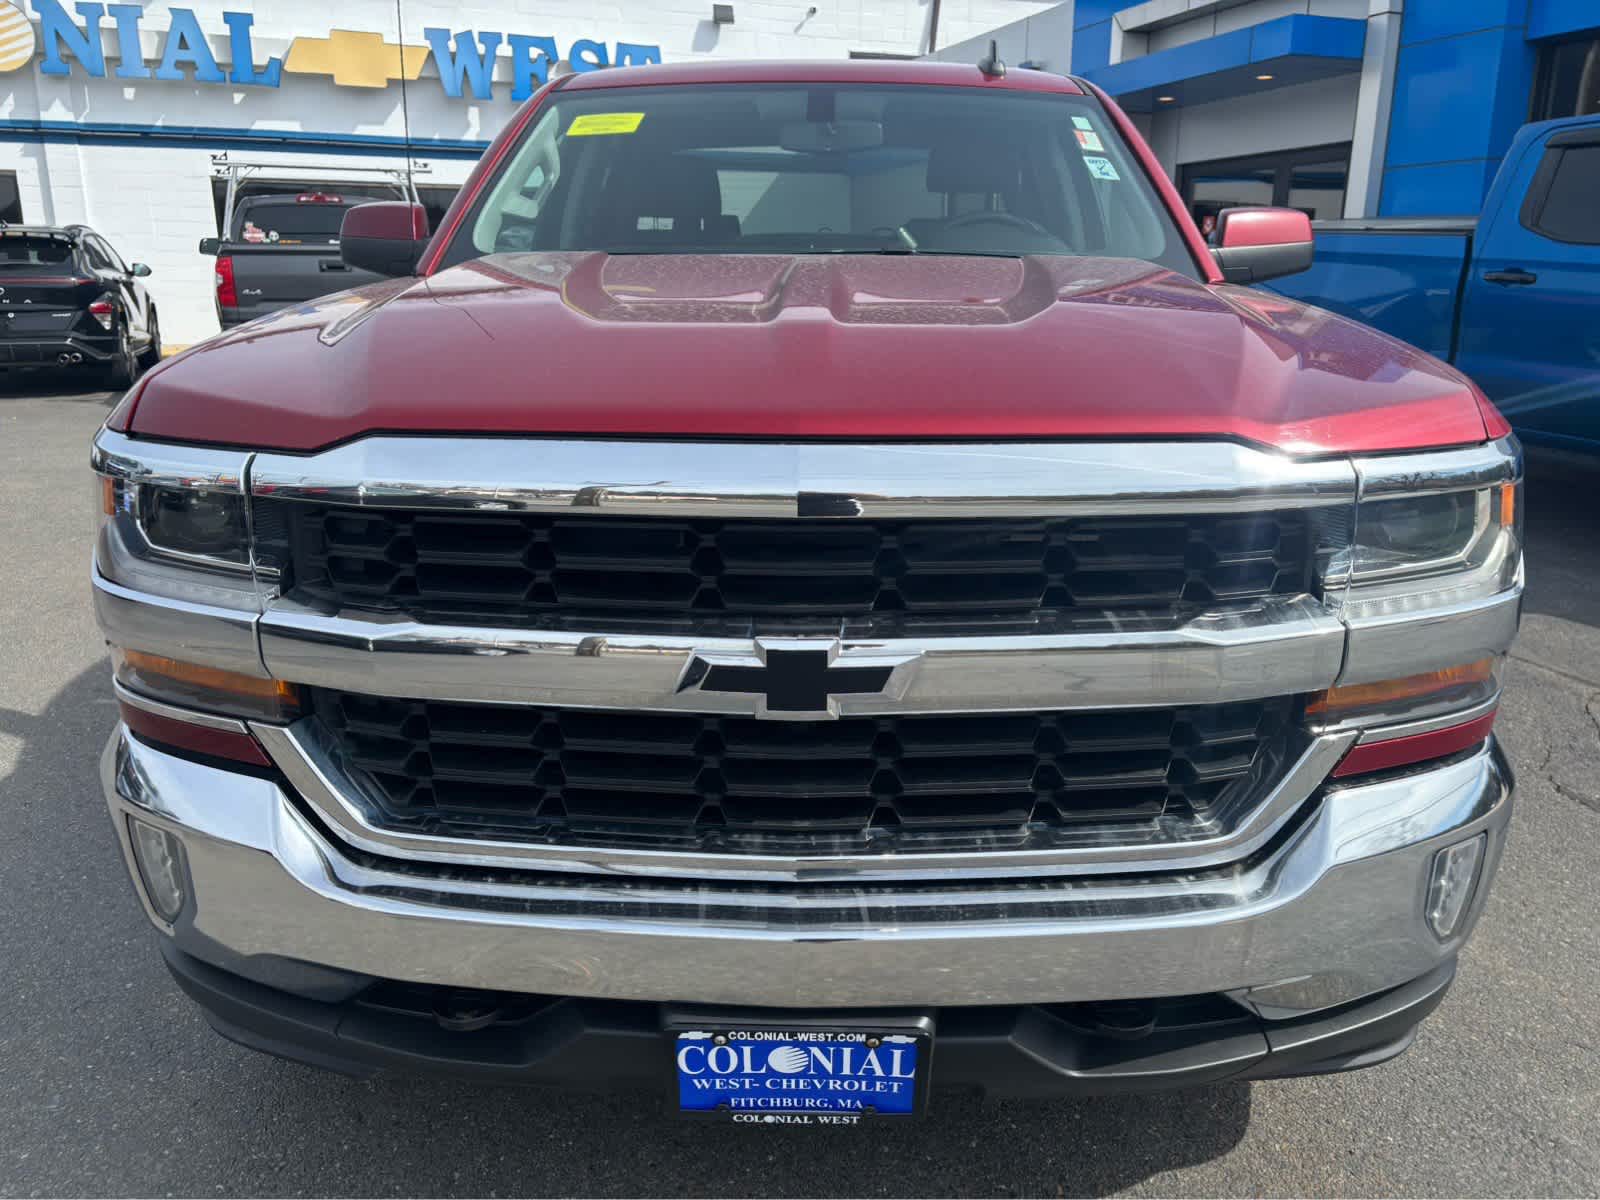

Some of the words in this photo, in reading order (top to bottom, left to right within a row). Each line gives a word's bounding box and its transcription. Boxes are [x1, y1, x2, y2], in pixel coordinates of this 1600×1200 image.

[728, 1031, 867, 1042] COLONIAL-WEST.COM
[677, 1045, 916, 1080] COLONIAL
[765, 1078, 904, 1093] CHEVROLET
[730, 1097, 833, 1109] FITCHBURG,
[837, 1099, 863, 1109] MA
[732, 1114, 813, 1124] COLONIAL
[818, 1115, 860, 1125] WEST
